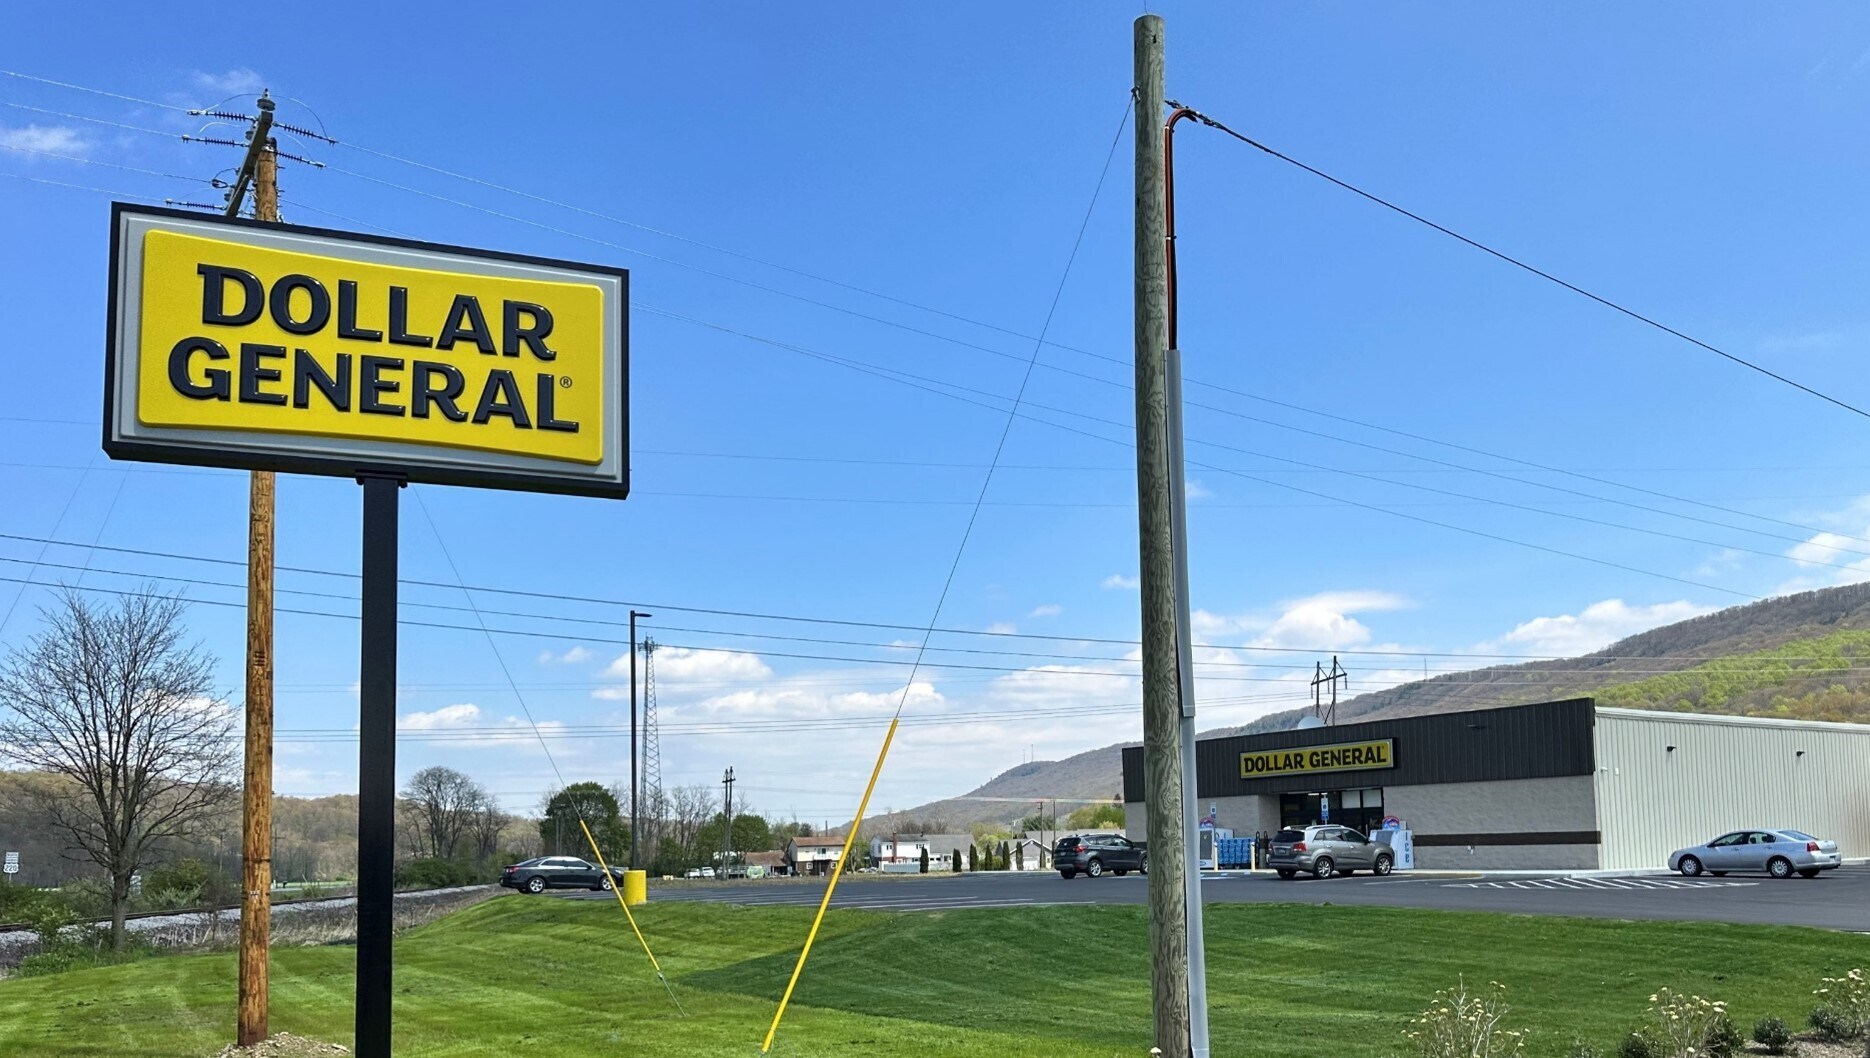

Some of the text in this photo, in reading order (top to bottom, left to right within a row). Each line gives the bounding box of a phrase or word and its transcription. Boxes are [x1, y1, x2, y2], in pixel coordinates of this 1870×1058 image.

[197, 263, 556, 361] DOLLAR
[1244, 746, 1386, 773] DOLLAR GENERAL
[4, 864, 18, 872] 220
